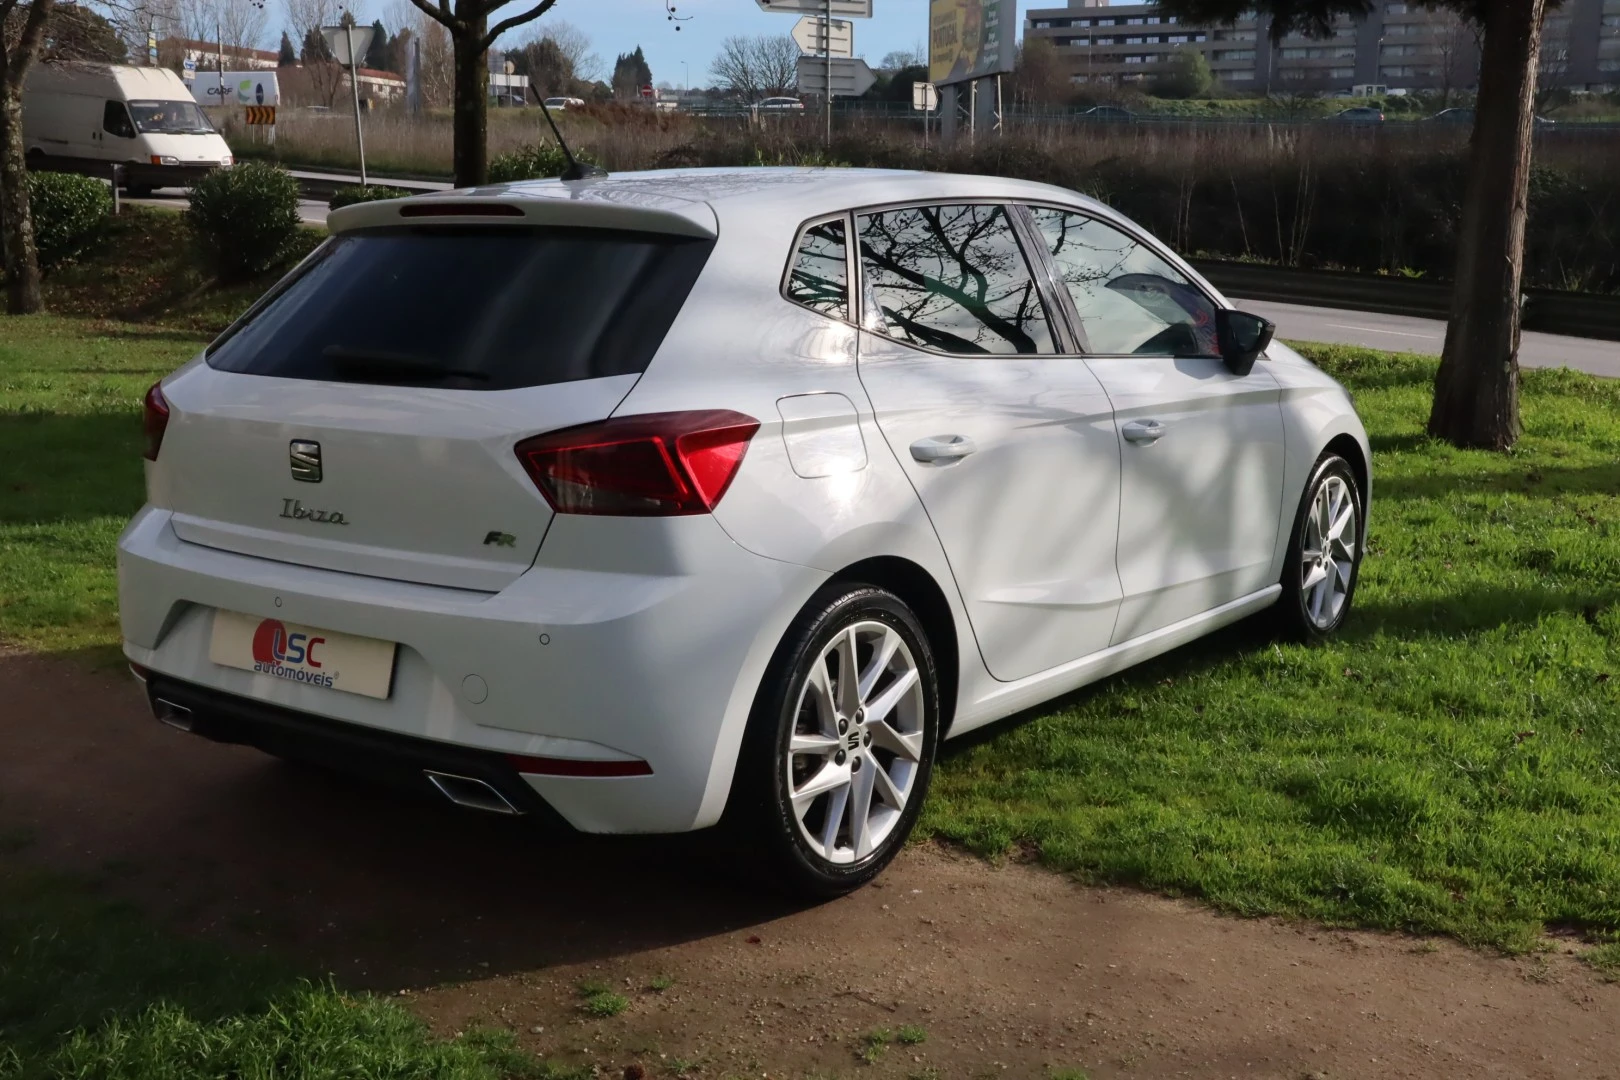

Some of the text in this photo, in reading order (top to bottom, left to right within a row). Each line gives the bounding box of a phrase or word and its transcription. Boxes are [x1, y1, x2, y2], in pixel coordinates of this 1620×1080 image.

[279, 497, 351, 526] Ibiza
[483, 530, 516, 548] FR
[272, 628, 326, 668] LSC
[253, 660, 334, 689] automóveis
